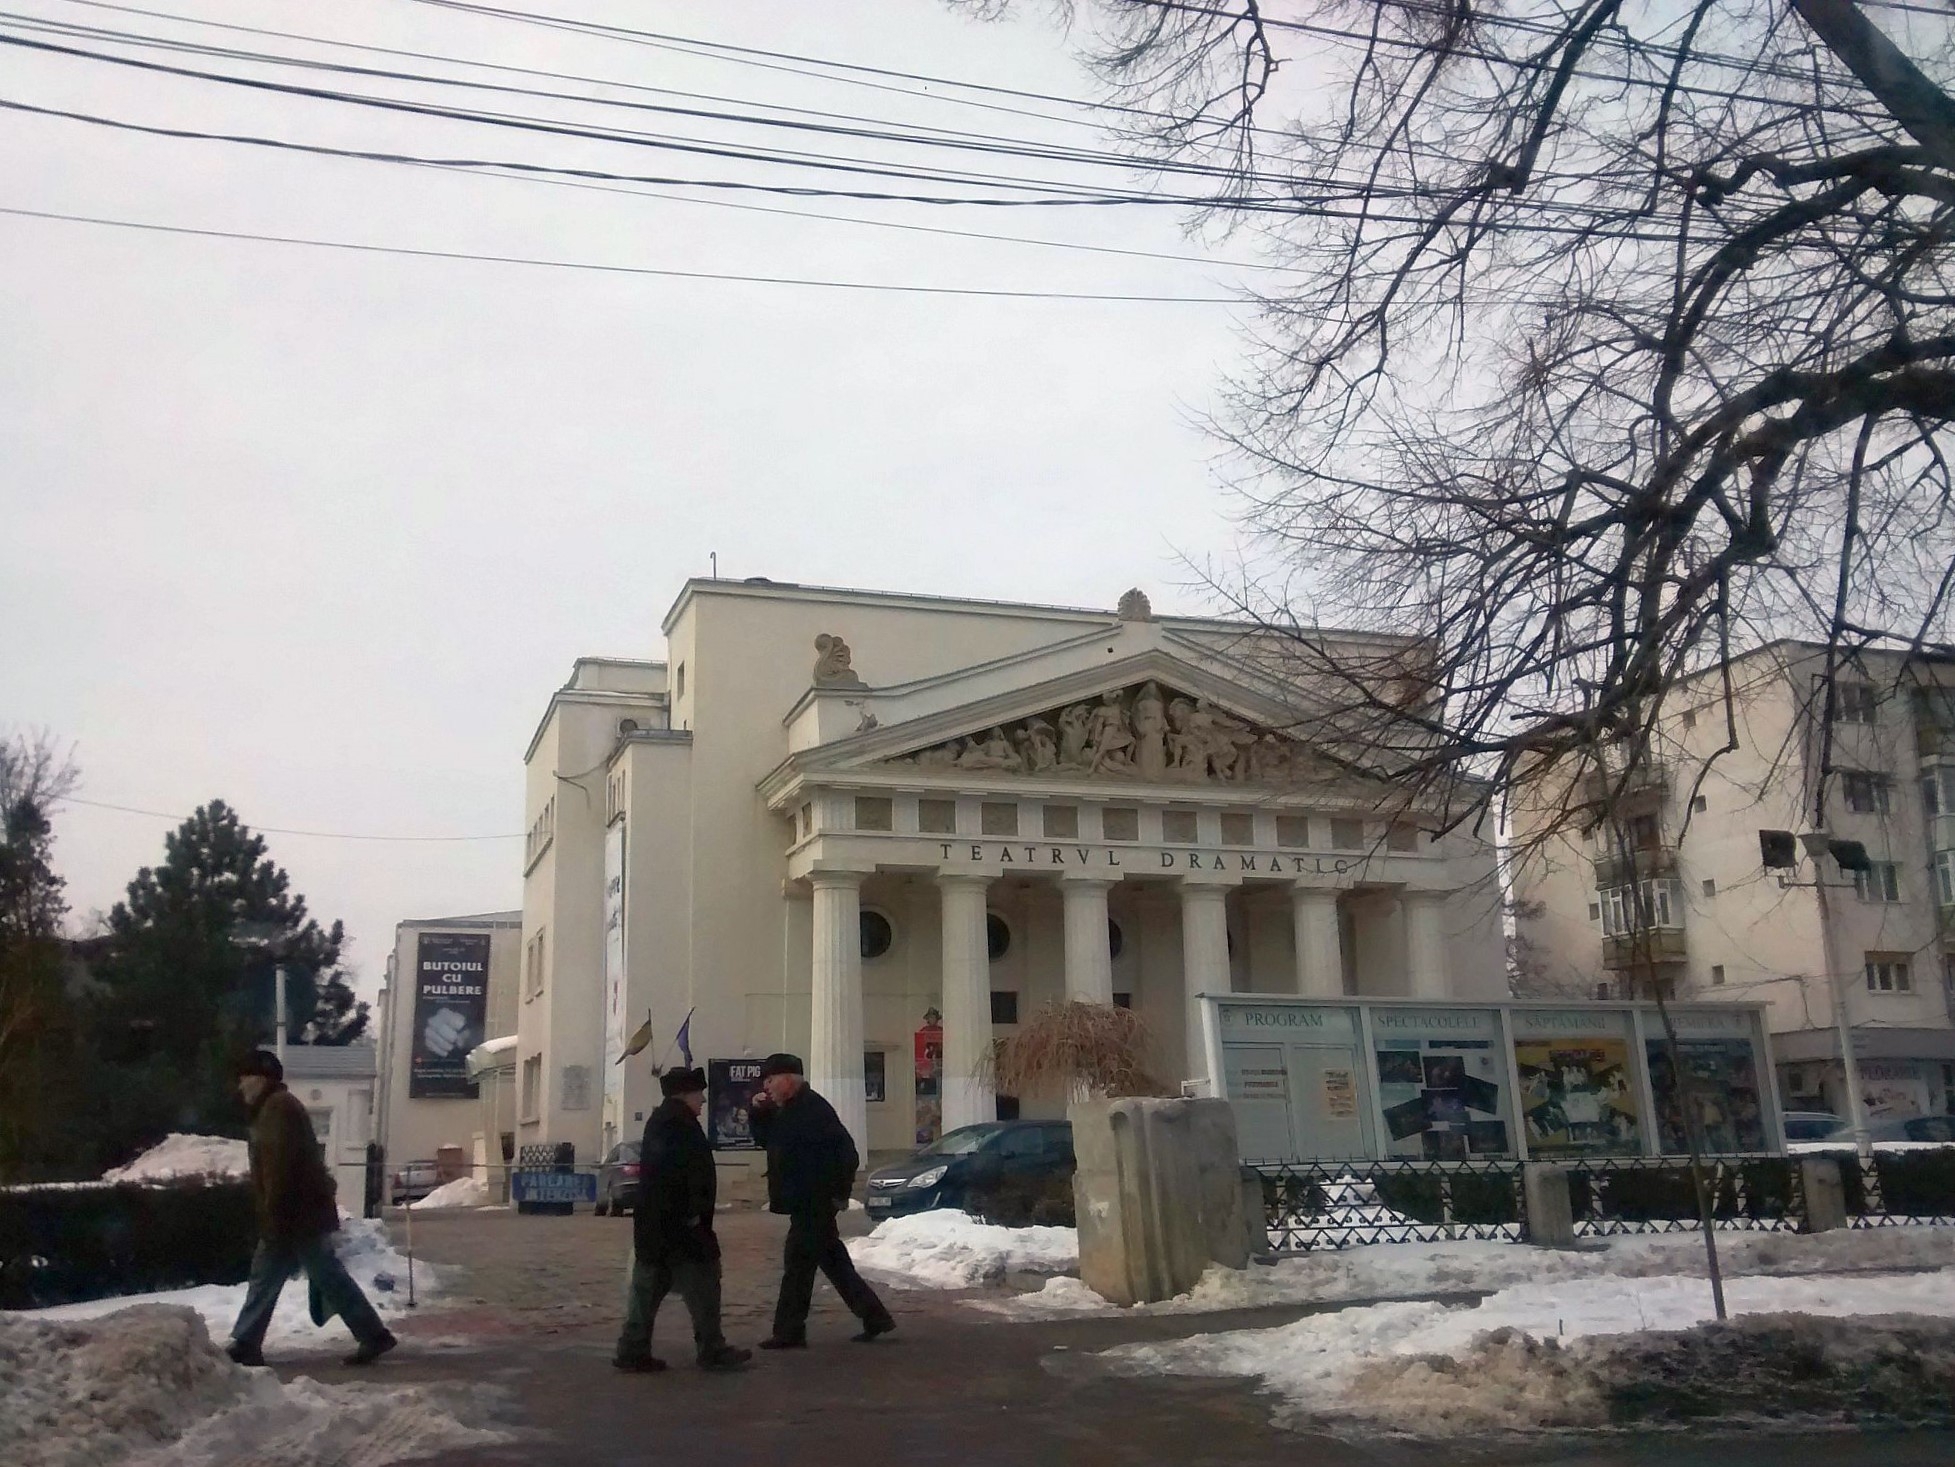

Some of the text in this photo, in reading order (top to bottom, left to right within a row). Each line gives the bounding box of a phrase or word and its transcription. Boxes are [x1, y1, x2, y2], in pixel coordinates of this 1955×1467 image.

[939, 843, 1348, 874] TEATRVL DRAMATIC
[423, 961, 483, 971] BUTOIUL
[442, 973, 462, 983] CU
[423, 985, 482, 995] PULBERE
[1245, 1012, 1323, 1027] PROGRAM
[730, 1065, 761, 1078] FAT PIG
